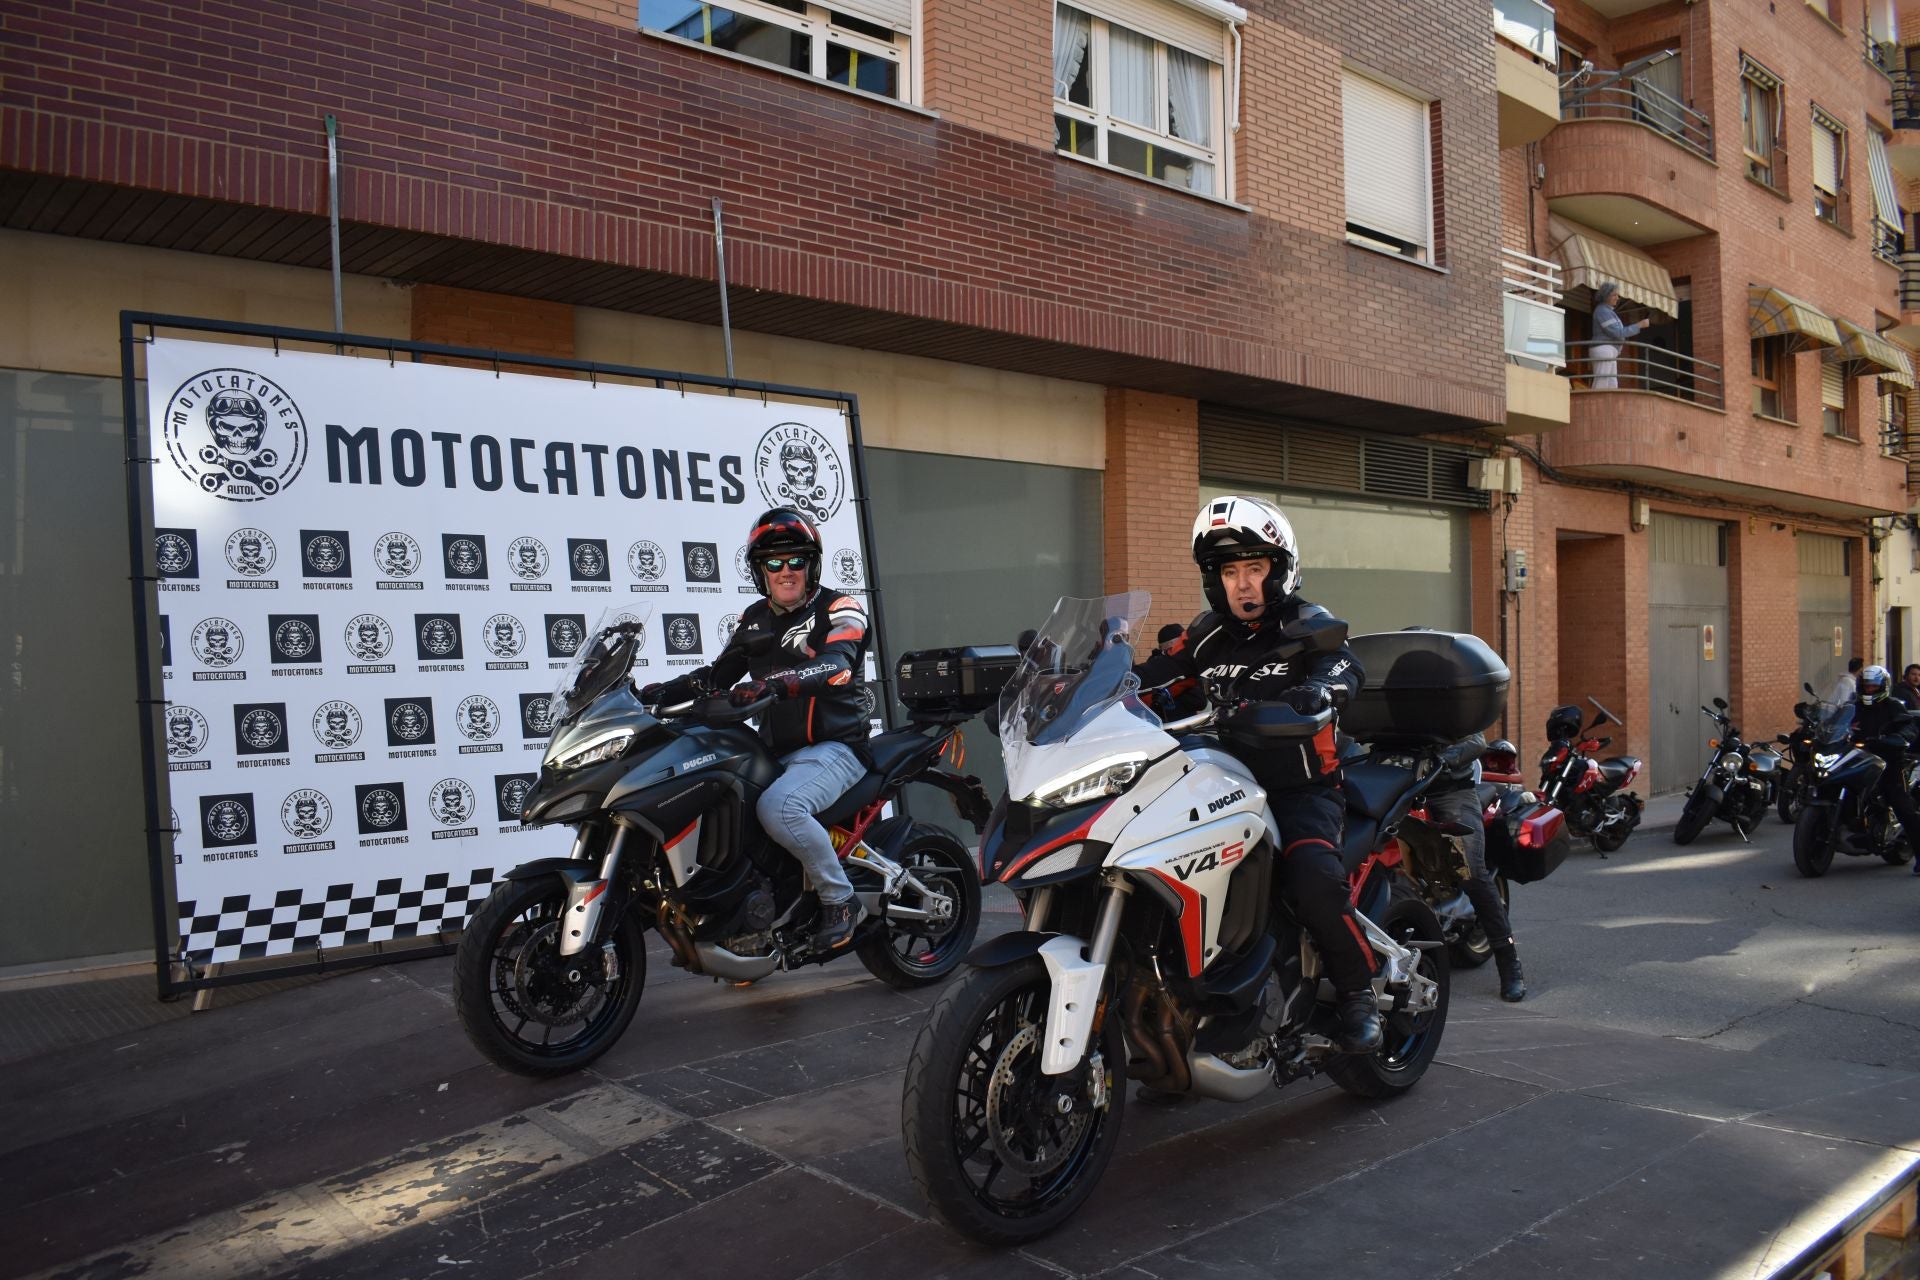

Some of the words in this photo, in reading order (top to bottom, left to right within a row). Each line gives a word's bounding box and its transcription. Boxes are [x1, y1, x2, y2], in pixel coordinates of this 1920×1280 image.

[173, 375, 299, 430] MOTOCATONES
[759, 428, 838, 471] MOTOCATONES
[325, 424, 745, 505] MOTOCATONES
[227, 484, 256, 496] AUTOL
[158, 584, 200, 592] TOCATONES
[229, 581, 277, 589] MOTOCATONES
[445, 583, 490, 591] MOTOCATONES
[571, 585, 612, 593] MOTOCATONES
[349, 665, 394, 673] MOTOCATONES
[418, 664, 465, 673] MOTOCATONES
[487, 662, 527, 670] MOTOCATONES
[195, 671, 244, 681] MOTOCATONES
[271, 668, 323, 677] MOTOCATONES
[388, 749, 437, 759] MOTOCATONES
[460, 744, 501, 754] MOTOCATONES
[317, 752, 363, 763] MOTOCATONES
[682, 753, 717, 771] DUCATI
[169, 761, 209, 771] TOCATONES
[237, 758, 290, 769] MOTOCATONES
[1207, 789, 1247, 814] DUCATI
[434, 828, 477, 839] MOTOCATONES
[359, 836, 409, 847] MOTOCATONES
[286, 842, 333, 853] MOTOCATONES
[203, 850, 258, 862] MOTOCATONES
[1173, 841, 1245, 881] V4S
